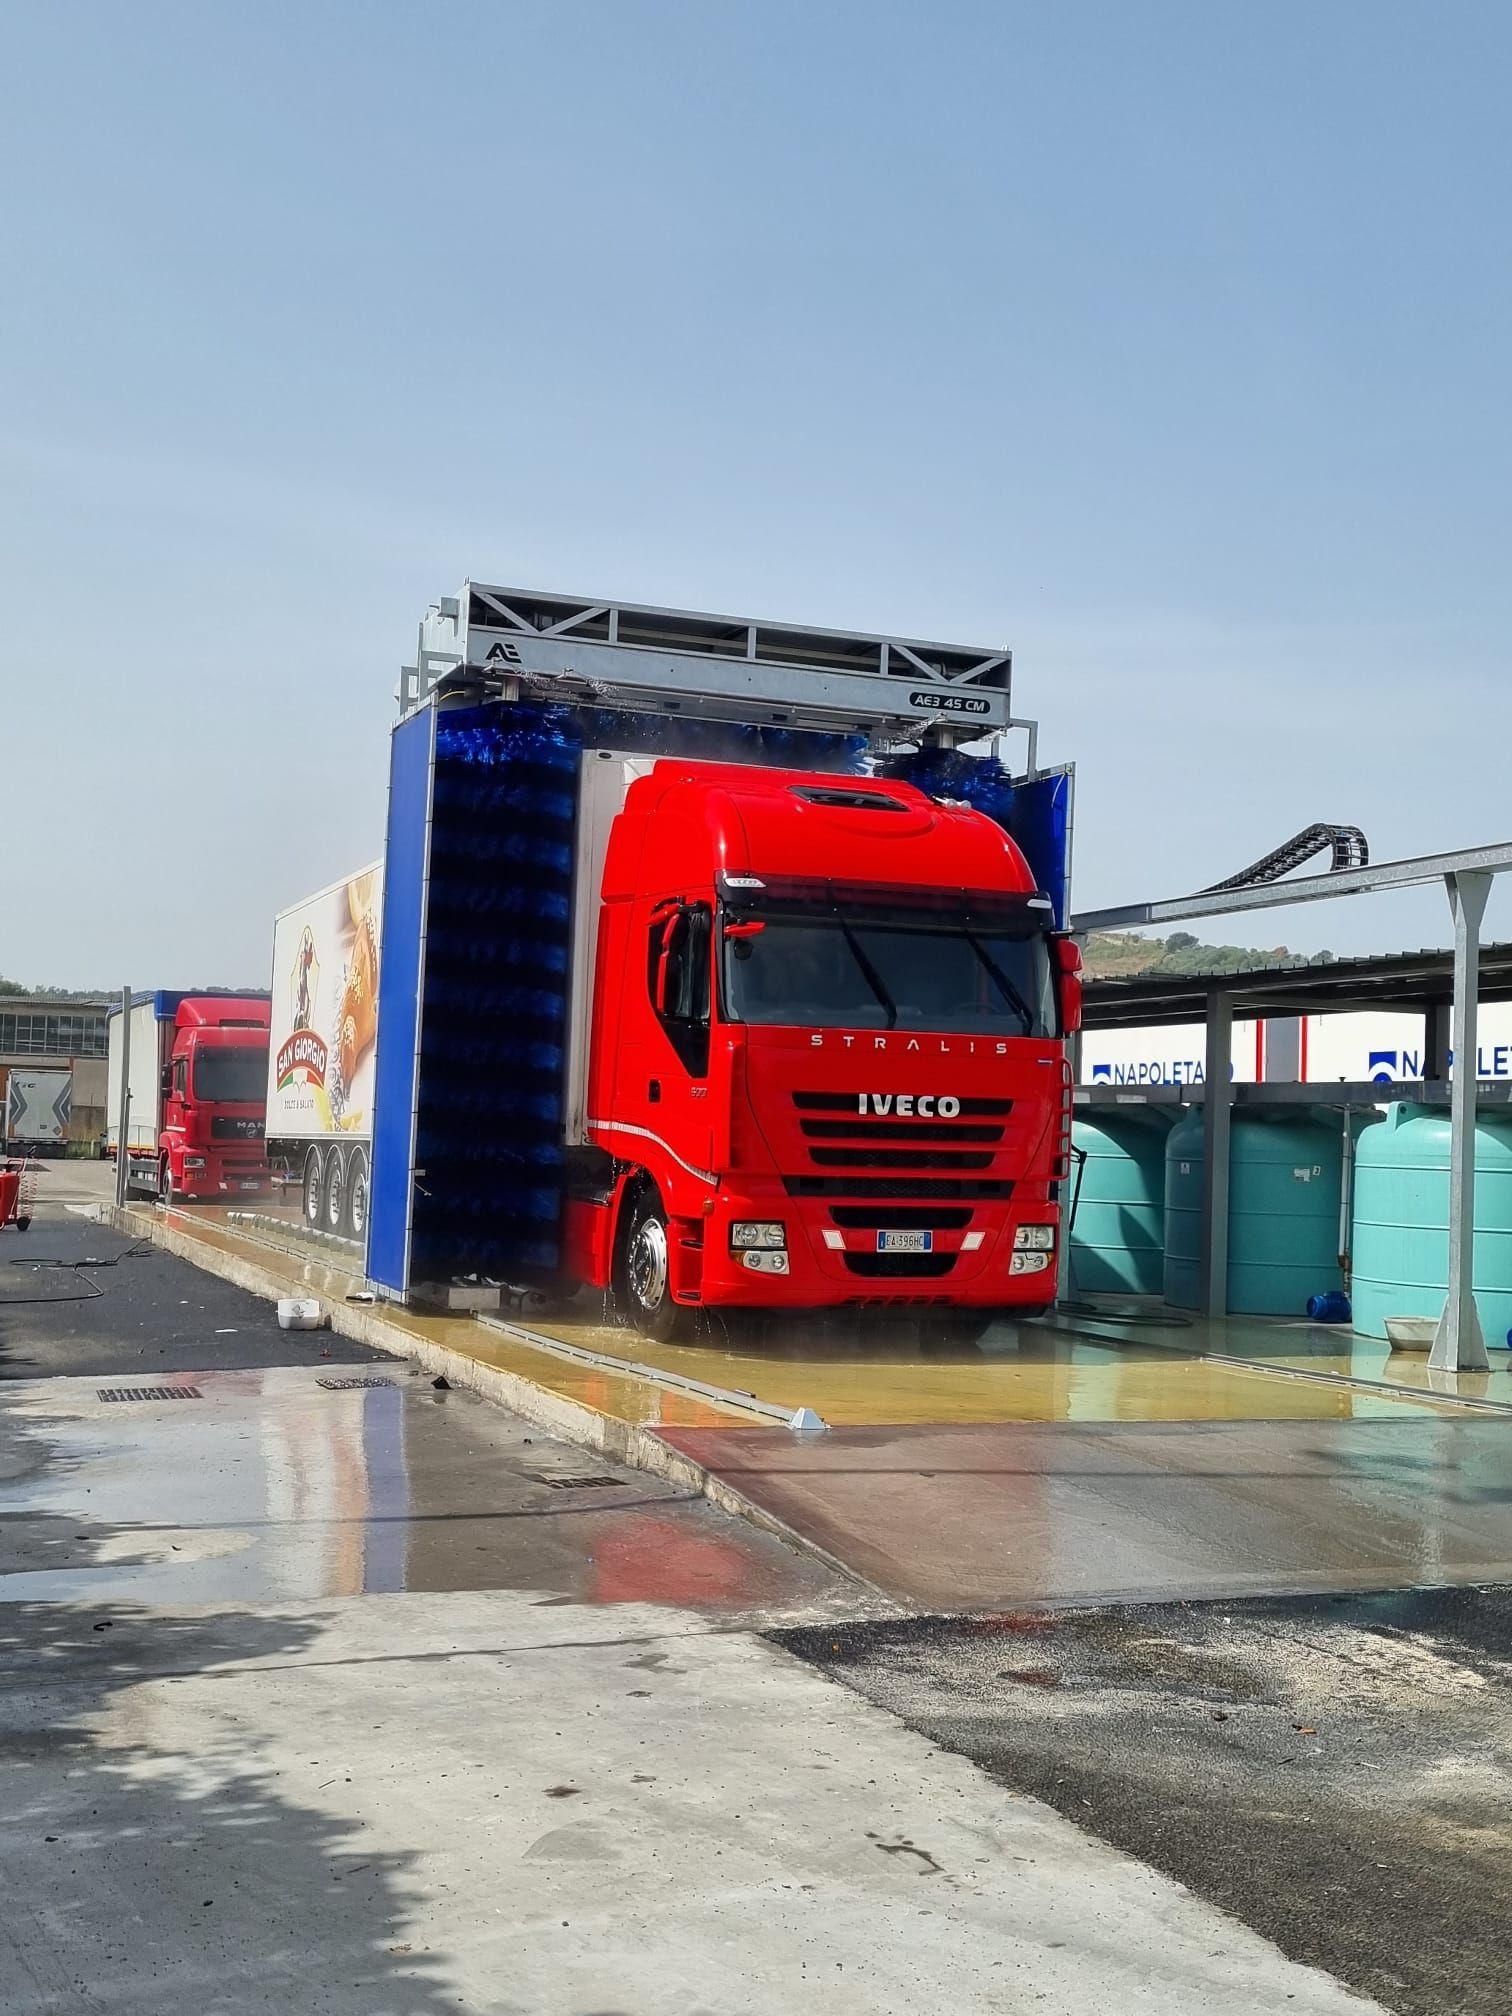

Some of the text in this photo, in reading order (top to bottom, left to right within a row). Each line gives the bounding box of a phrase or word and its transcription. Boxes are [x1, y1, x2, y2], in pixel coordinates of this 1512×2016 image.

[485, 642, 522, 664] AE
[914, 694, 985, 712] AE3 45 CM
[811, 1034, 1007, 1054] STRALIS
[278, 1037, 325, 1078] SAN GIORGIO
[858, 1093, 961, 1118] IVECO
